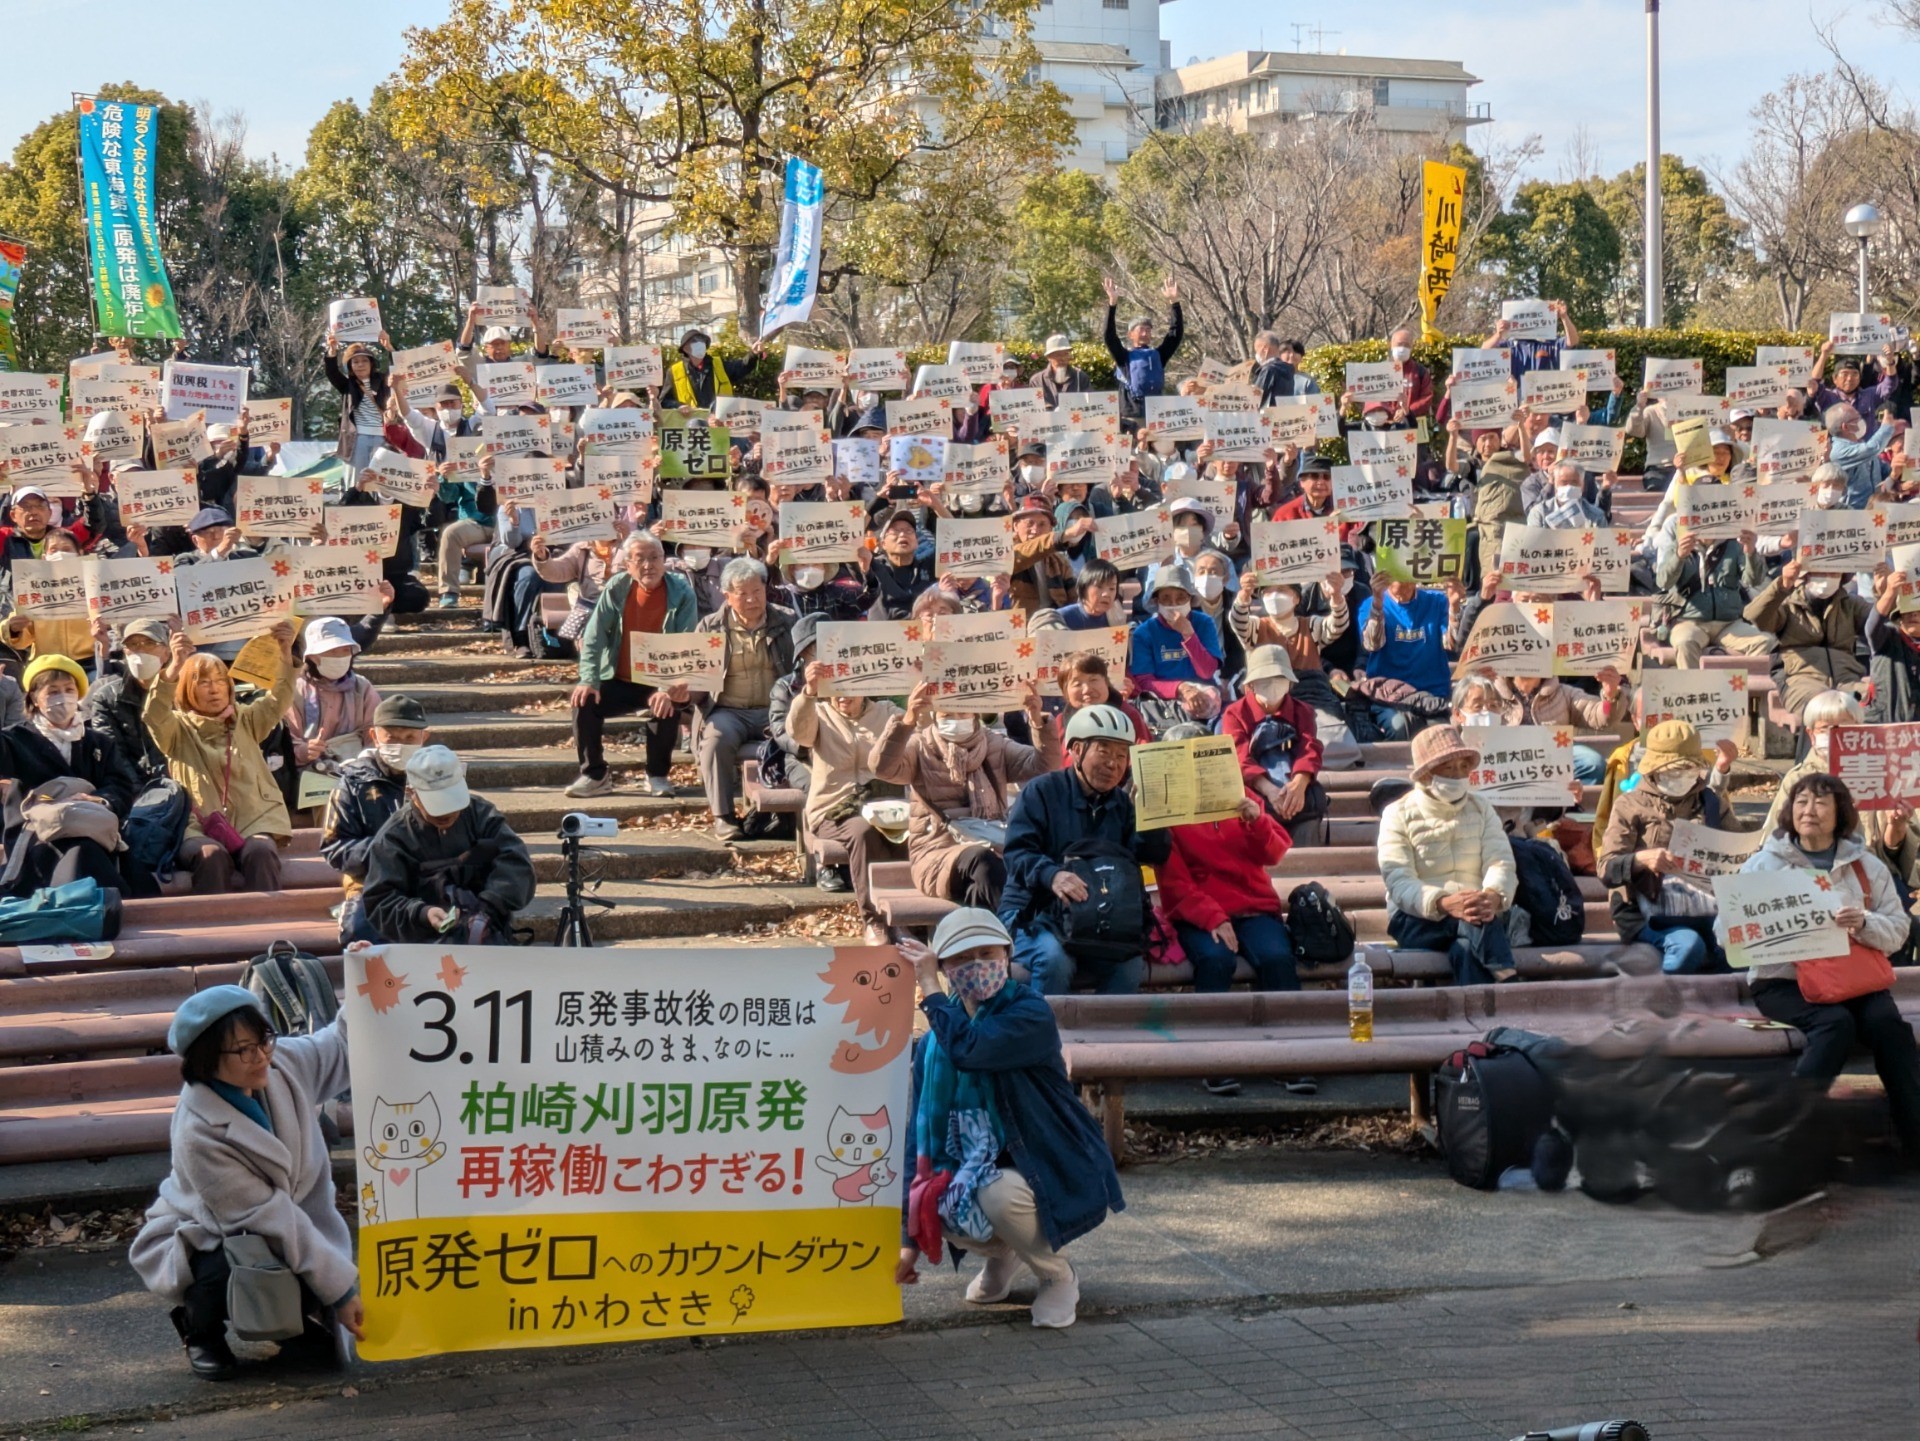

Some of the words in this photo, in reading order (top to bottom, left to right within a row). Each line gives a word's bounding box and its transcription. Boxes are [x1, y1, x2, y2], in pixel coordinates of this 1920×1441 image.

[101, 104, 147, 335] 危険な東海第二原発は廃炉に
[0, 399, 58, 411] 発はいらない
[11, 442, 59, 455] 私の未来に
[660, 428, 712, 452] 原発
[683, 453, 727, 476] ゼロ
[381, 467, 419, 480] 地震大国に
[133, 486, 178, 499] 地震大国に
[1348, 480, 1391, 493] 私の未来に
[122, 495, 197, 515] 原発はいらない
[254, 495, 302, 507] 地震大国に
[1338, 489, 1410, 507] 原発はいらない
[1692, 499, 1737, 512] 私の未来に
[240, 504, 322, 522] 原発はいらない
[678, 507, 725, 517] 私の未来に
[1679, 508, 1754, 526] 原発はいらない
[340, 522, 384, 535] 地震大国に
[665, 518, 744, 530] 原発はいらない
[796, 519, 844, 533] 私の未来に
[783, 529, 862, 549] 原発はいらない
[953, 535, 999, 548] 地震大国に
[1110, 526, 1155, 543] 私の未来に
[1379, 519, 1444, 549] 原発
[1816, 528, 1865, 541] 地震大国に
[1100, 533, 1173, 561] 原発はいらない
[1269, 536, 1319, 552] 私の未来に
[1801, 540, 1884, 556] 原発はいらない
[939, 545, 1013, 563] 原発はいらない
[1255, 547, 1339, 570] 原発はいらない
[1520, 549, 1574, 559] 私の未来に
[304, 565, 359, 580] 私の未来に
[1406, 552, 1461, 580] ゼロ
[1503, 559, 1591, 575] 原発はいらない
[30, 576, 81, 589] 私の未来に
[100, 576, 152, 591] 地震大国に
[202, 580, 266, 602] 地震大国に
[90, 587, 174, 609] 原発はいらない
[187, 591, 292, 626] 原発はいらない
[1573, 622, 1626, 638] 私の未来に
[648, 649, 701, 660] 私の未来に
[838, 643, 897, 658] 地震大国に
[634, 659, 722, 674] 原発はいらない
[822, 656, 920, 679] 原発はいらない
[945, 662, 1008, 678] 地震大国に
[926, 673, 1031, 695] 原発はいらない
[1663, 692, 1721, 709] 私の未来に
[1484, 747, 1545, 765] 地震大国に
[1468, 763, 1571, 785] 原発はいらない
[1743, 893, 1812, 918] 私の未来に
[555, 988, 817, 1028] 原発事故後の問題は
[408, 989, 533, 1065] 3.11
[460, 1078, 808, 1135] 柏崎刈羽原発
[456, 1143, 805, 1199] 再稼働こわすぎる!
[376, 1228, 881, 1298] 原発ゼロへのカウントダウン
[509, 1298, 539, 1331] in
[552, 1296, 712, 1331] かわさき
